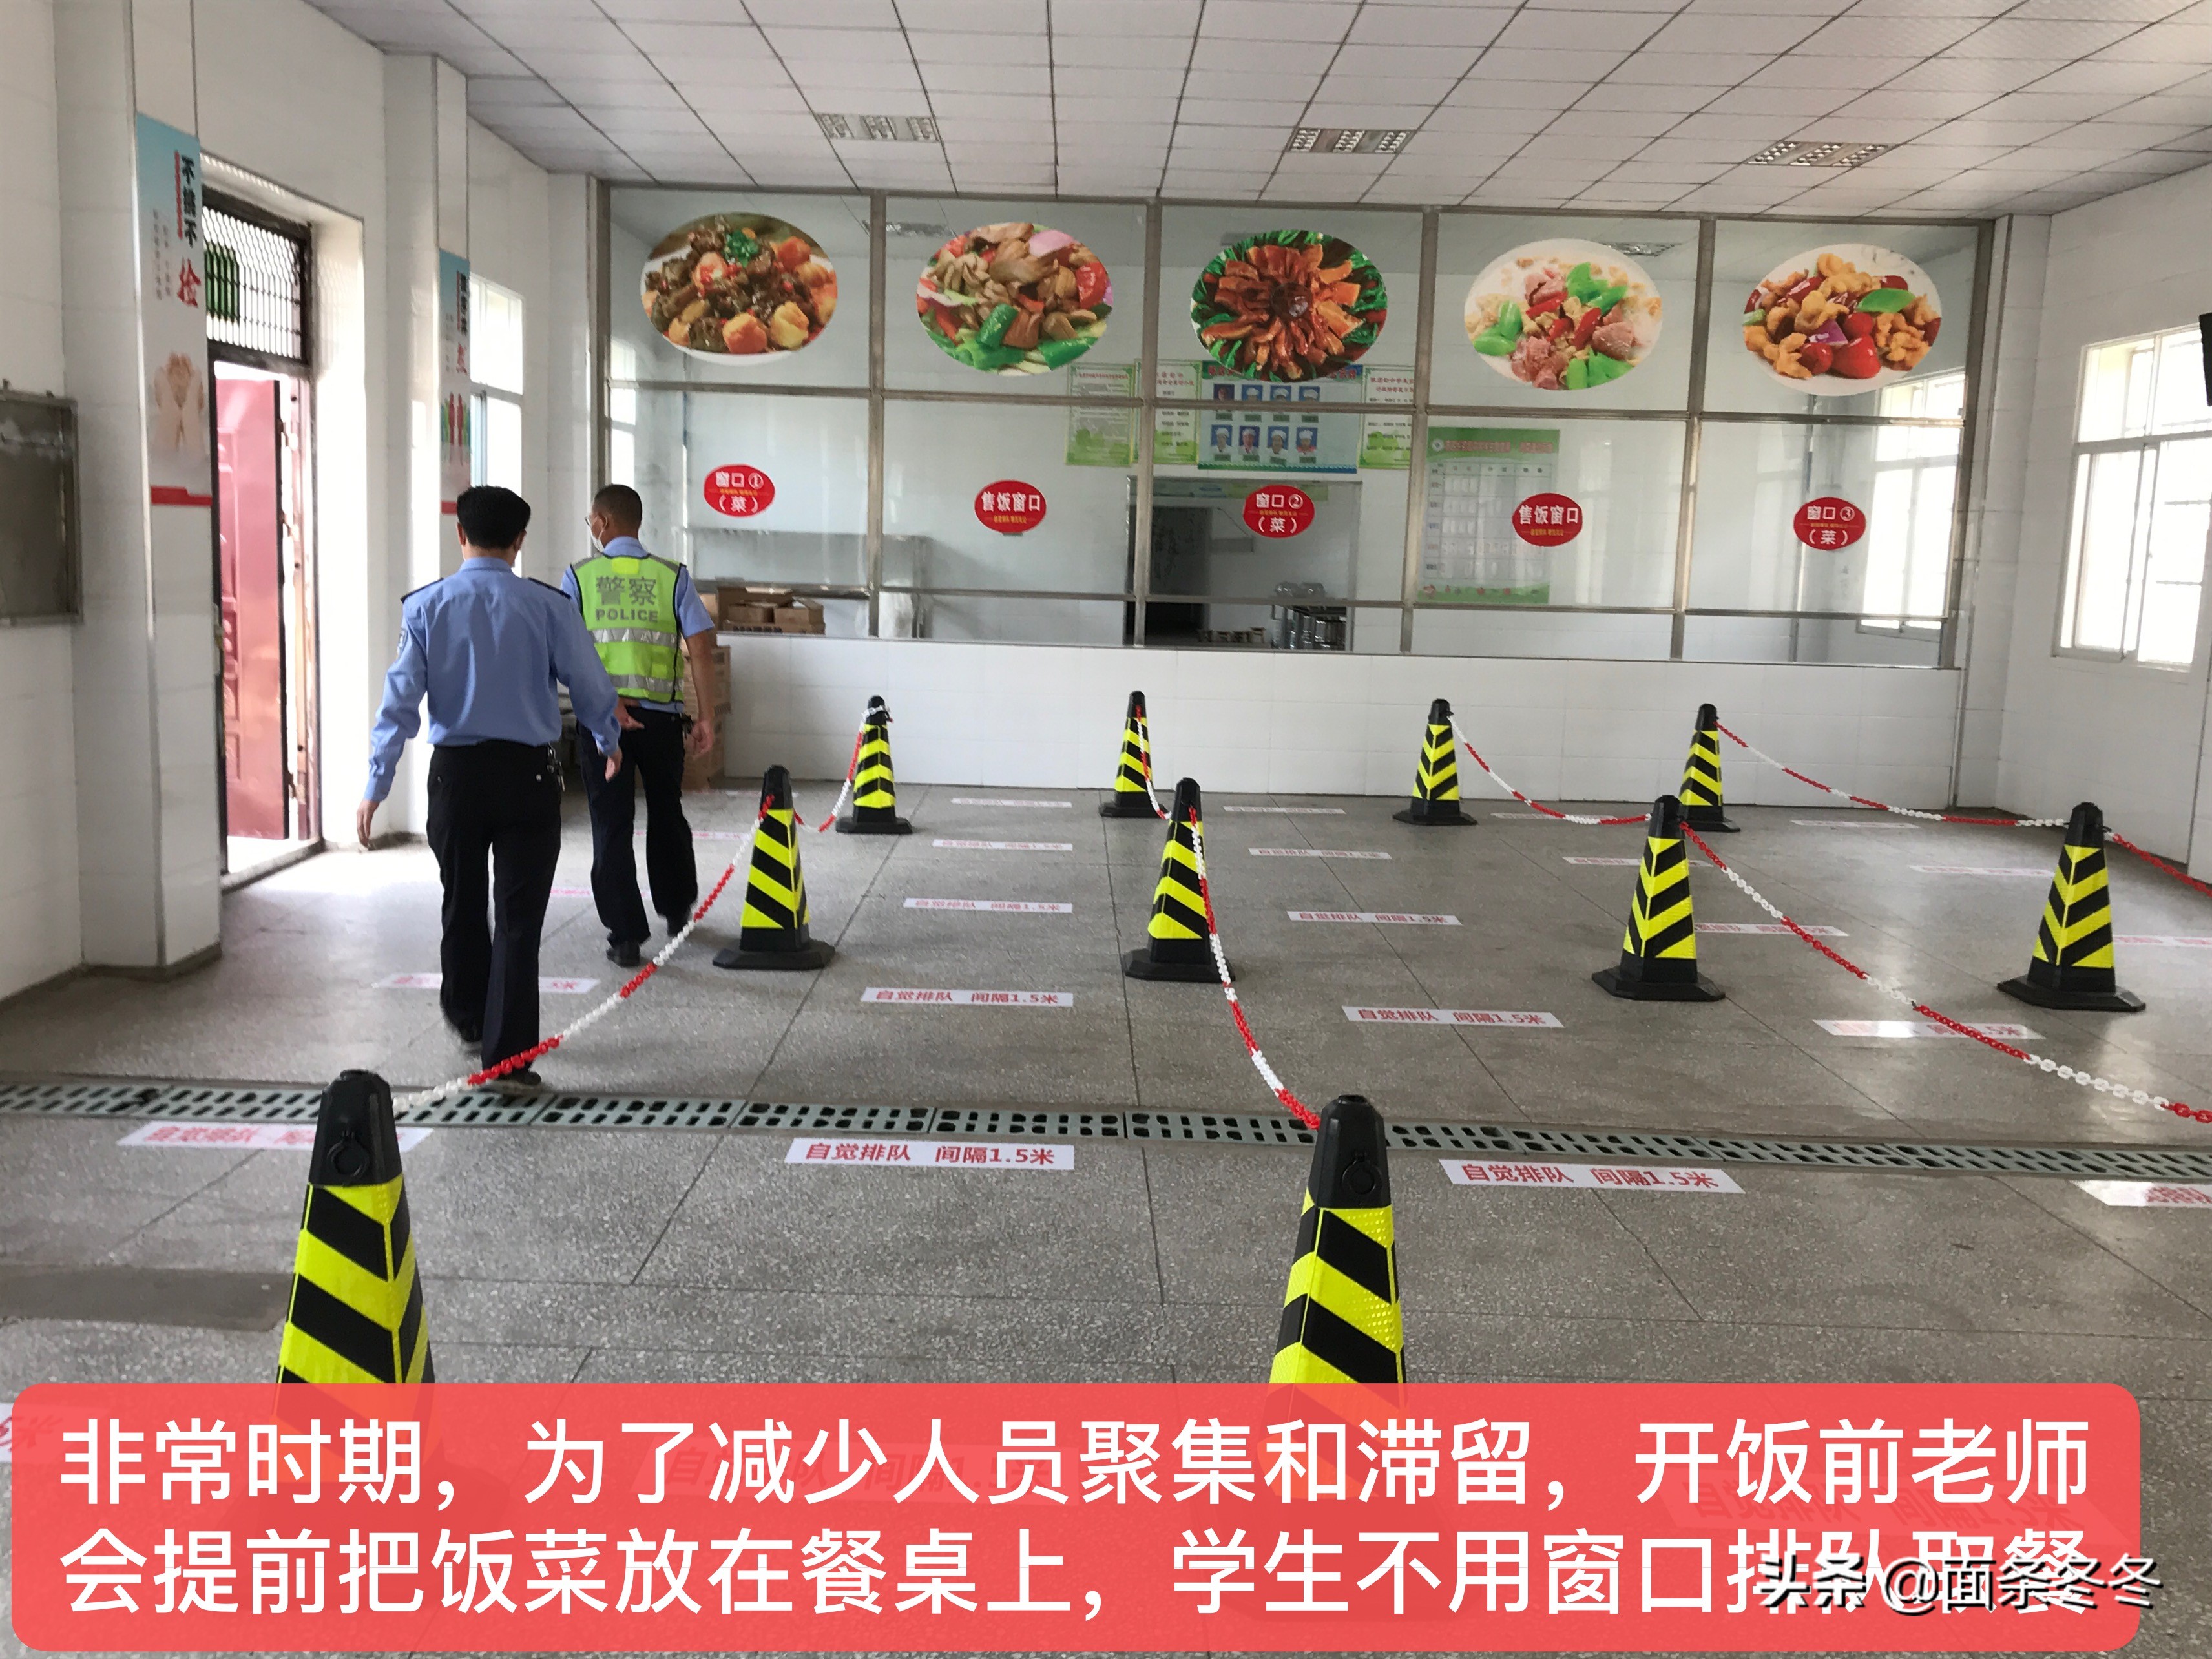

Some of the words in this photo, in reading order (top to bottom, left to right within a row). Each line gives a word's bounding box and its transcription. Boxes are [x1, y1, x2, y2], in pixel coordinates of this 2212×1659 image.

[716, 471, 745, 488] 窗口
[981, 491, 1040, 512] 售饭窗口
[1256, 493, 1284, 508] 窗口
[1519, 505, 1578, 525] 售饭窗口
[1807, 505, 1835, 520] 窗口
[596, 576, 658, 607] 警察
[596, 608, 658, 623] POLICE
[1299, 912, 1363, 922] 自觉排队
[1374, 913, 1448, 924] 间隔1.5米
[876, 990, 953, 1002] 自觉排队
[971, 992, 1059, 1005] 间隔1.5米
[1357, 1009, 1439, 1022] 自觉排队
[1452, 1012, 1546, 1026] 间隔1.5米
[806, 1143, 912, 1161] 自觉排队
[935, 1146, 1055, 1165] 间隔1.5米
[1461, 1163, 1574, 1184] 自觉排队
[1589, 1168, 1719, 1189] 间隔1.5米
